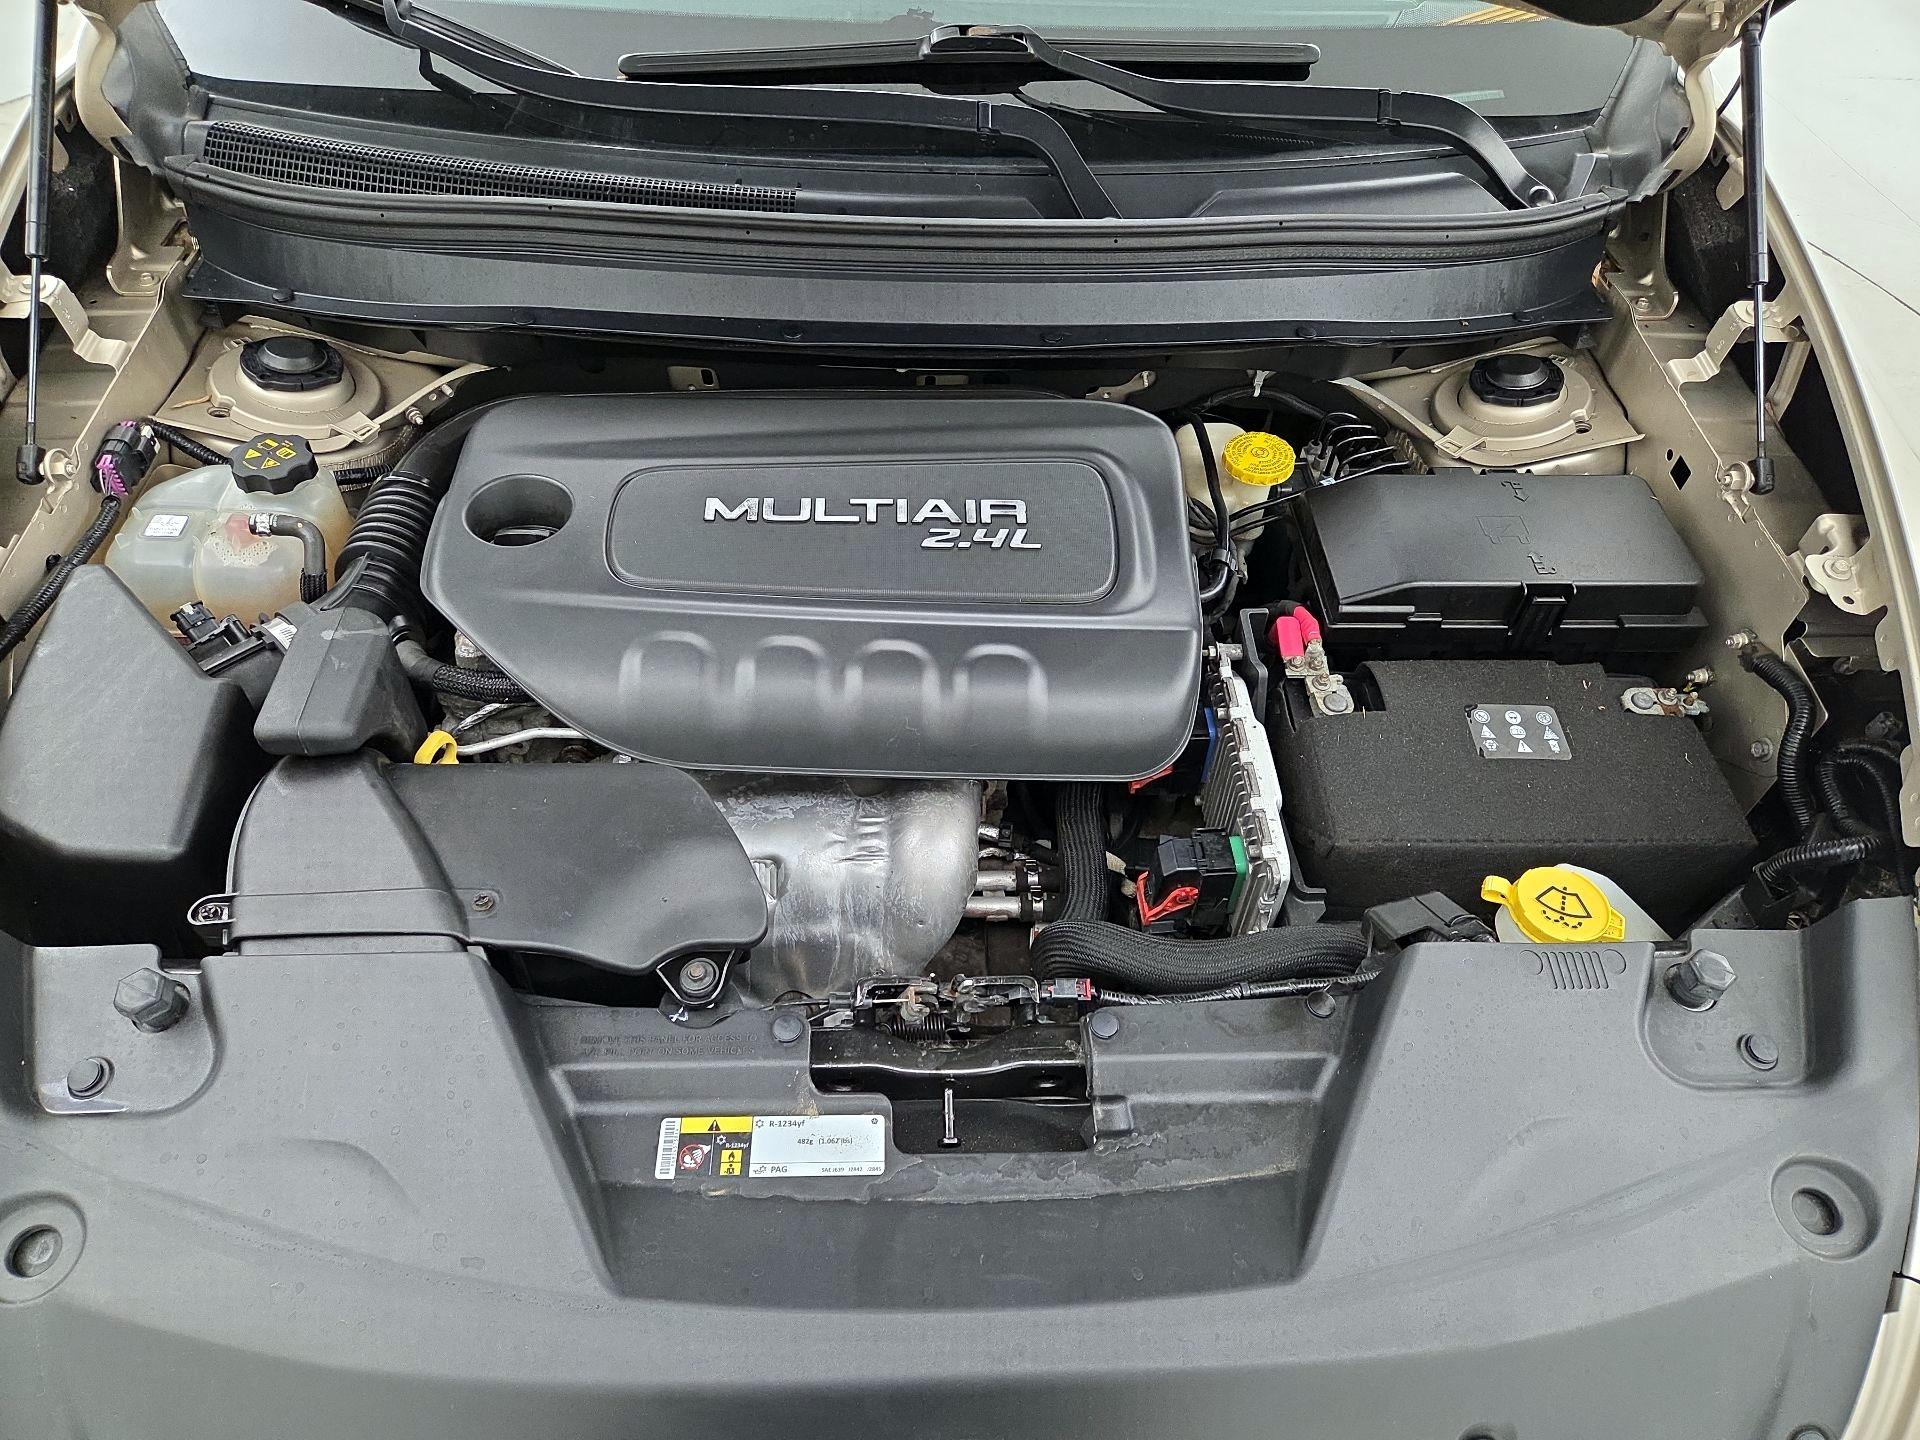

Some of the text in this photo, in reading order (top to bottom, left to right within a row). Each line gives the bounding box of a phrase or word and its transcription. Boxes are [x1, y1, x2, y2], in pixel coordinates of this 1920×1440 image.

[704, 497, 1027, 523] MULTIAIR
[920, 528, 1042, 548] 2.4L
[682, 1034, 702, 1043] FOR
[704, 1033, 742, 1042] ACCESS
[745, 1033, 757, 1042] TO
[657, 1047, 672, 1055] ON
[675, 1046, 704, 1055] SOME
[708, 1045, 755, 1055] VEHICLES
[769, 1119, 805, 1129] R-1234yf
[797, 1138, 814, 1146] 482g
[770, 1165, 788, 1173] PAG
